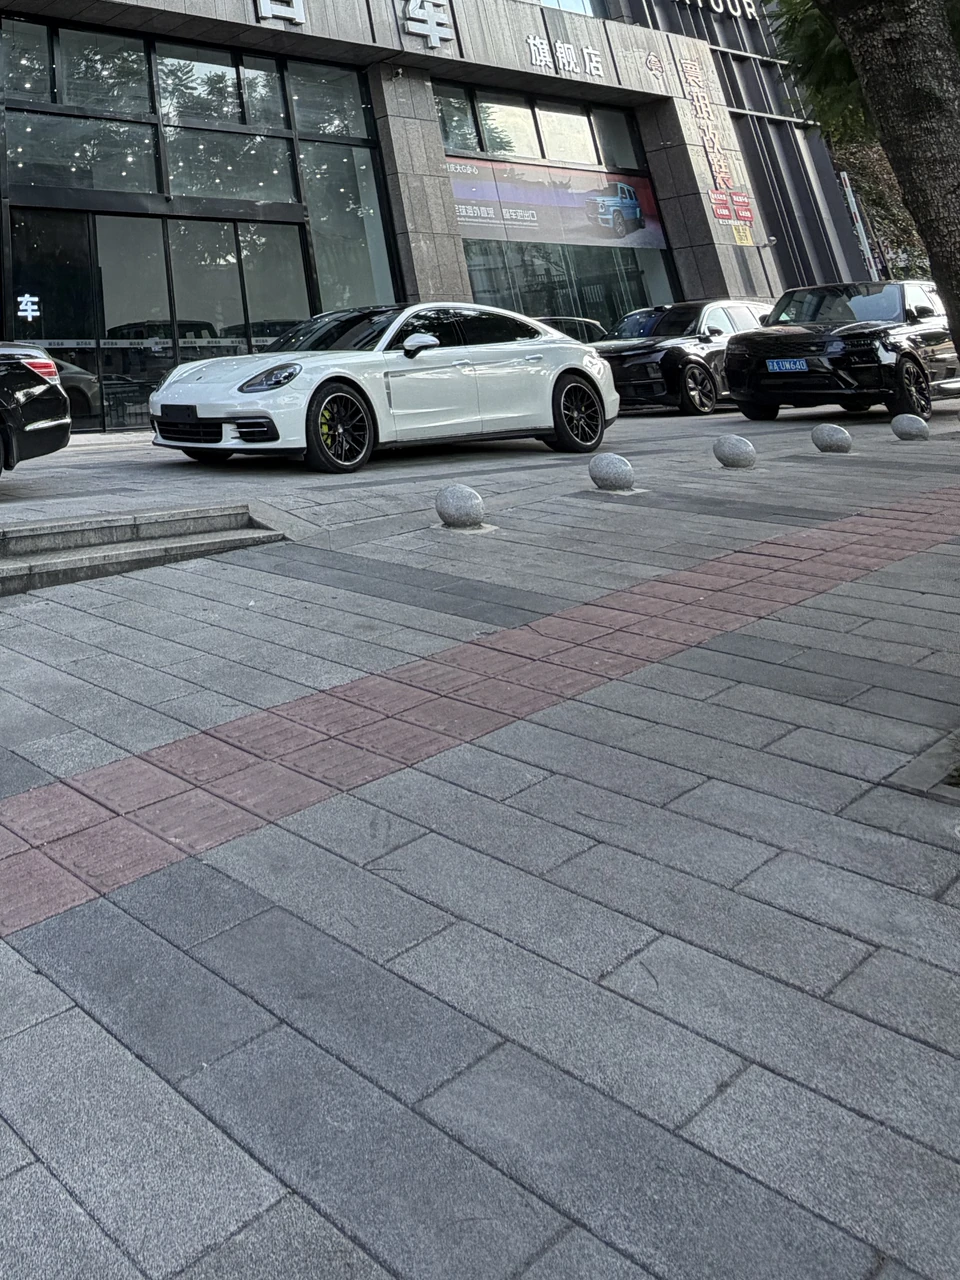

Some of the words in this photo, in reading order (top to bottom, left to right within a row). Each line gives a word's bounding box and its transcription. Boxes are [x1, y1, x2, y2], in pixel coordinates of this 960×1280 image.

[526, 34, 604, 77] 旗舰店
[445, 163, 478, 175] 庆大G中心
